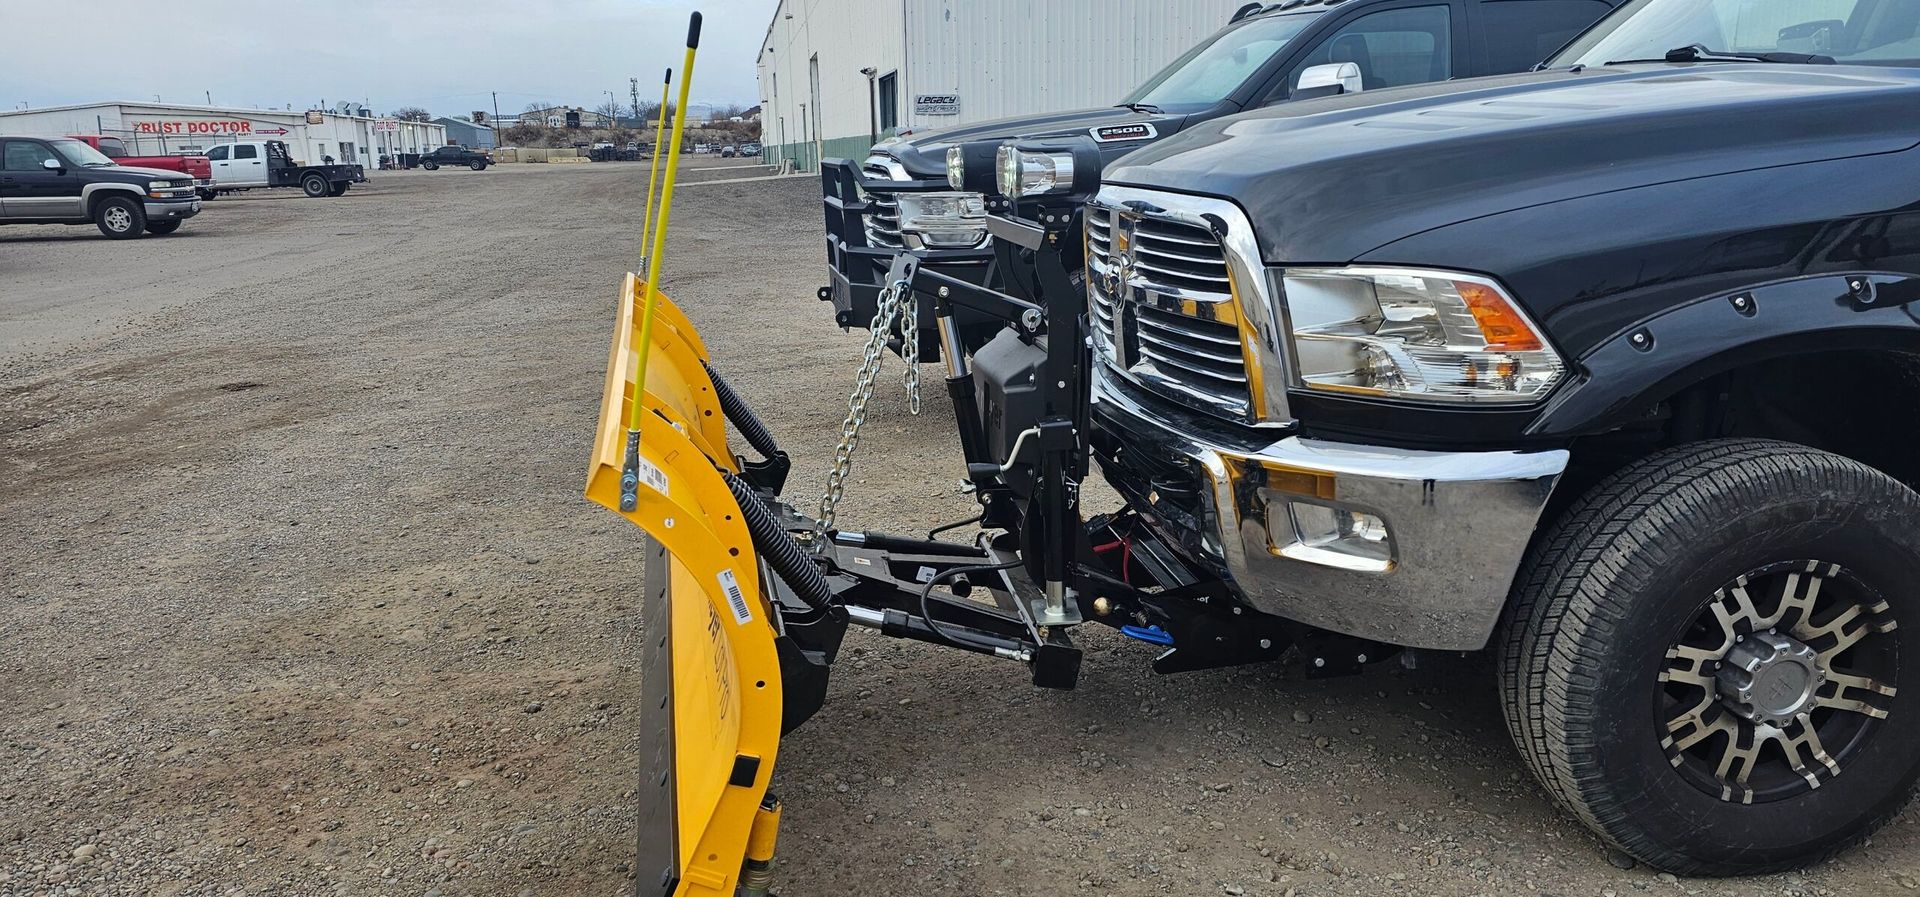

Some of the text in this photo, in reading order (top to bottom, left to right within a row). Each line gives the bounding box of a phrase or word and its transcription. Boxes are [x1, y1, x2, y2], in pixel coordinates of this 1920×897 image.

[141, 122, 182, 133] RUST
[188, 121, 252, 133] DOCTOR
[1101, 126, 1144, 135] 2500
